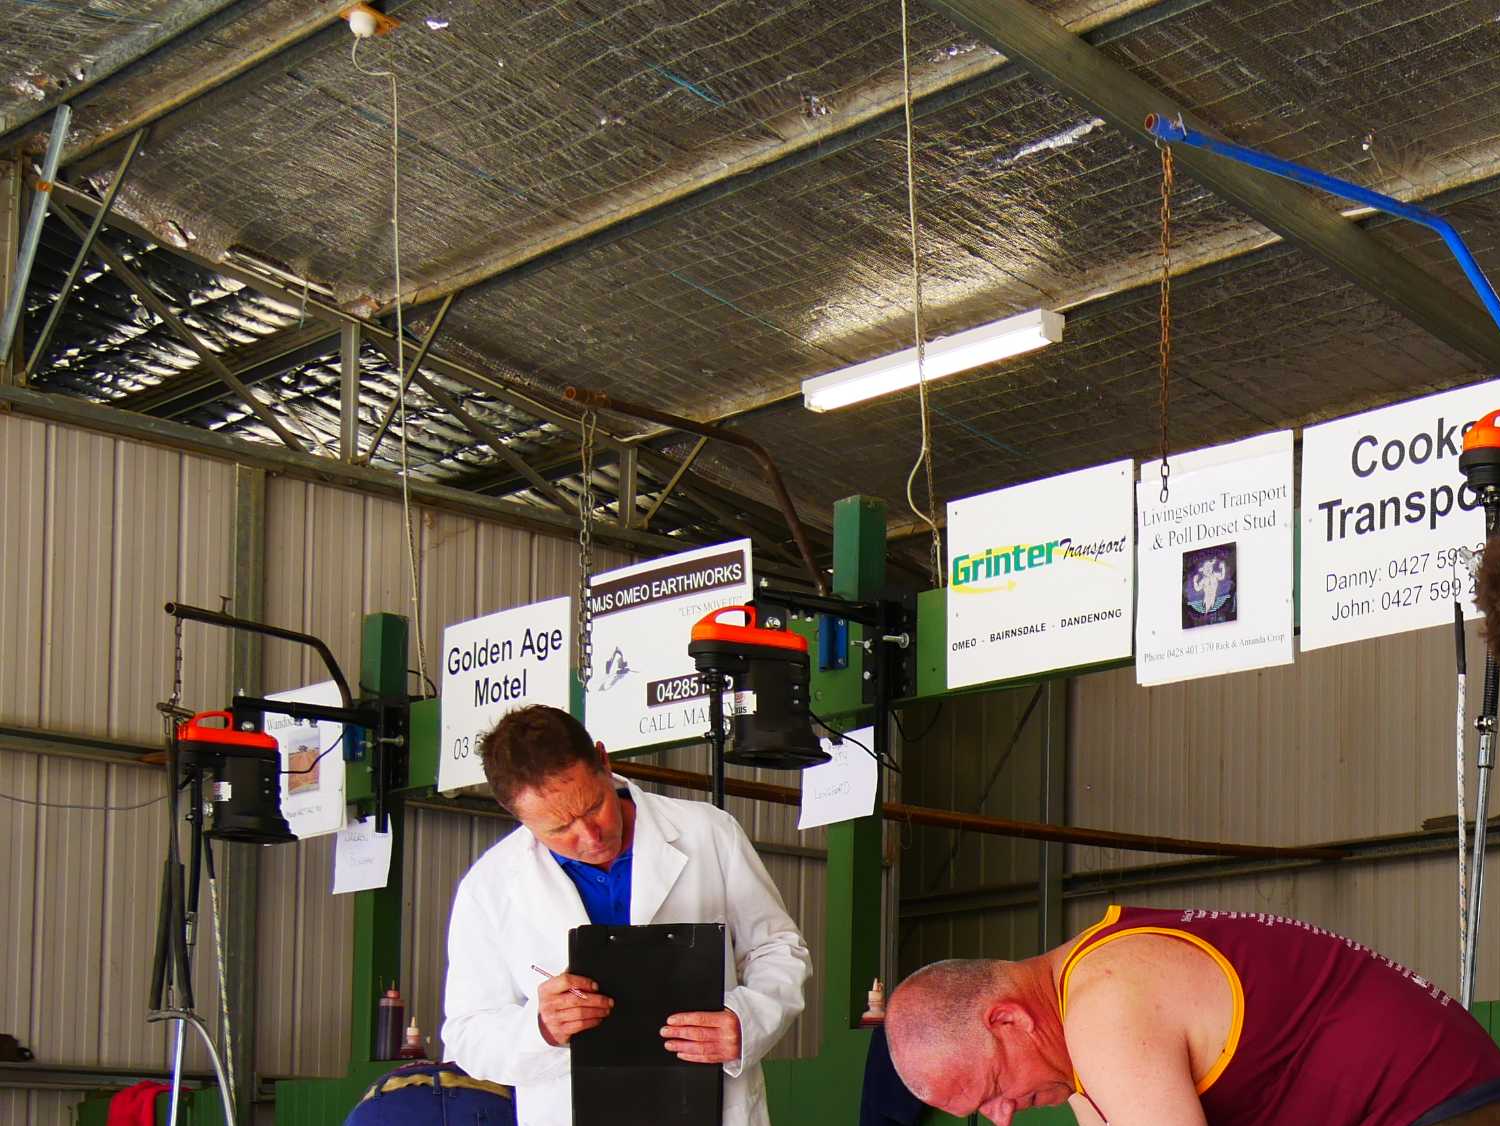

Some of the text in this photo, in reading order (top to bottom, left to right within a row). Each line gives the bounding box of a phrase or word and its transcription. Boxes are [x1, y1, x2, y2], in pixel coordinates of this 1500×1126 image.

[1141, 482, 1288, 528] Livingstone Transport
[1318, 478, 1486, 543] Transpo
[1152, 508, 1277, 551] & Poll Dorset Stud
[952, 536, 1127, 587] Grinter Transport
[1326, 567, 1383, 593] Danny:
[1388, 552, 1431, 579] 0427
[591, 563, 743, 614] MJS OMEO EARTHWORKS
[1331, 600, 1376, 622] John:
[1381, 584, 1424, 611] 0427
[951, 607, 1123, 652] OMEO BAIRNSDALE DANDENONG
[448, 627, 564, 677] Golden Age
[473, 668, 528, 708] Motel
[638, 711, 676, 736] CALL
[452, 735, 470, 761] 03
